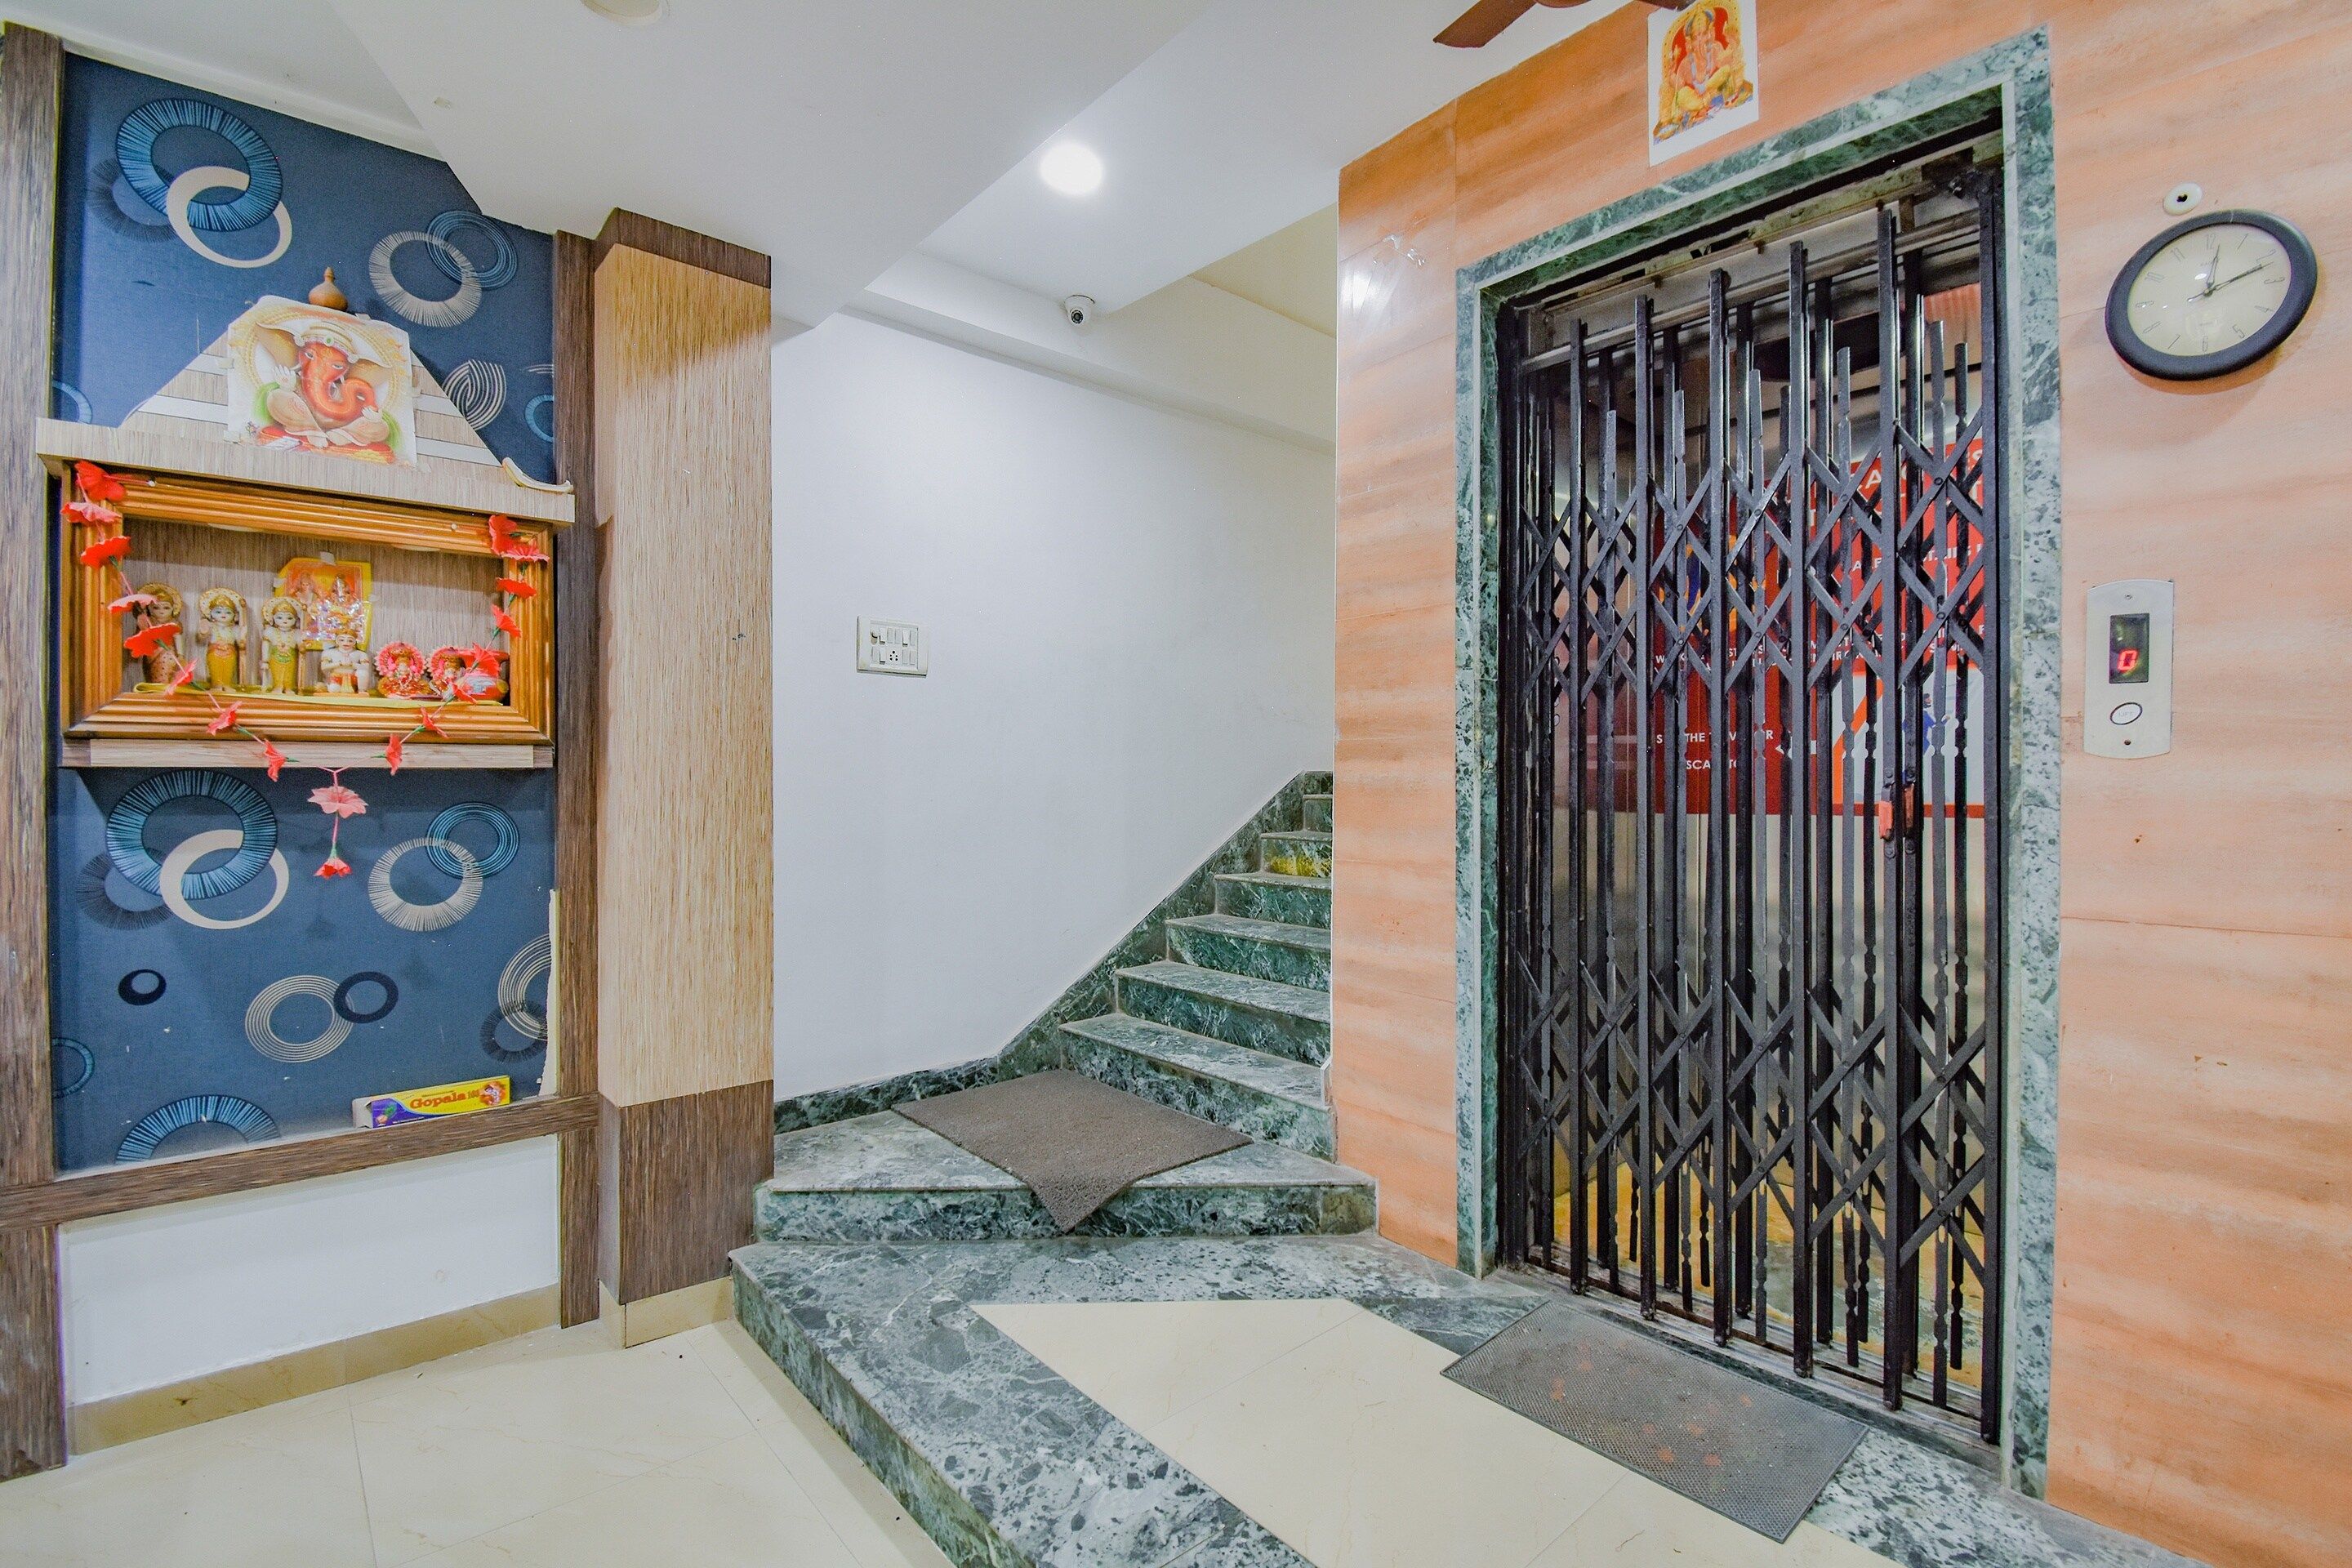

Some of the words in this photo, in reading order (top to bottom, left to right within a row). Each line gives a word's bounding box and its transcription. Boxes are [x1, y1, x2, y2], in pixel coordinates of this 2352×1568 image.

[2206, 234, 2216, 250] 12
[2171, 247, 2185, 262] 11
[2264, 276, 2285, 284] 3
[2232, 323, 2245, 339] 5
[1685, 733, 1705, 742] THE
[410, 1092, 466, 1109] Gopala
